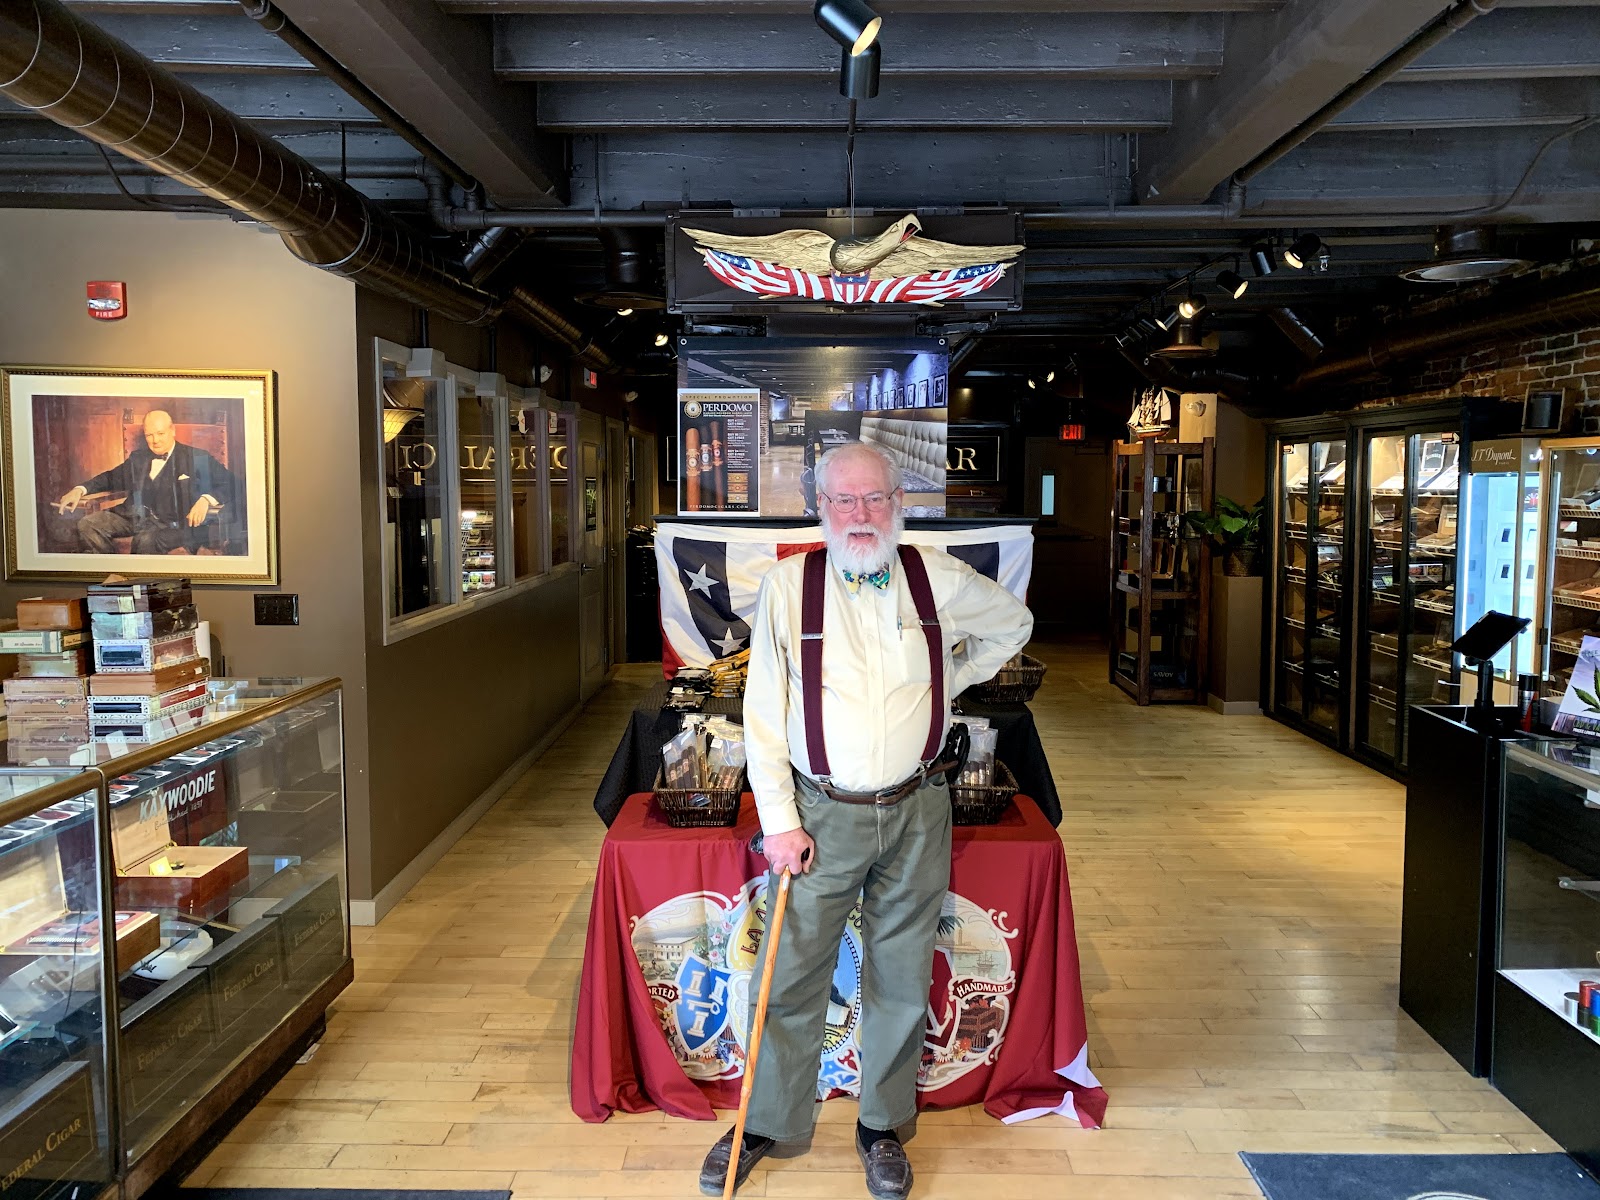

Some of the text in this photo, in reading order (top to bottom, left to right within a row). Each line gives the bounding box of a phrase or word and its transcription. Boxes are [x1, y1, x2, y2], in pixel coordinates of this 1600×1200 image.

[703, 403, 753, 412] PERDOMO
[1485, 446, 1517, 465] Dupont
[139, 769, 217, 825] KAYWOODIE
[223, 958, 275, 1002] FEDERAL CIGAR
[956, 982, 1009, 998] HANDMADE
[0, 1118, 81, 1192] EDERAL CIGAR
